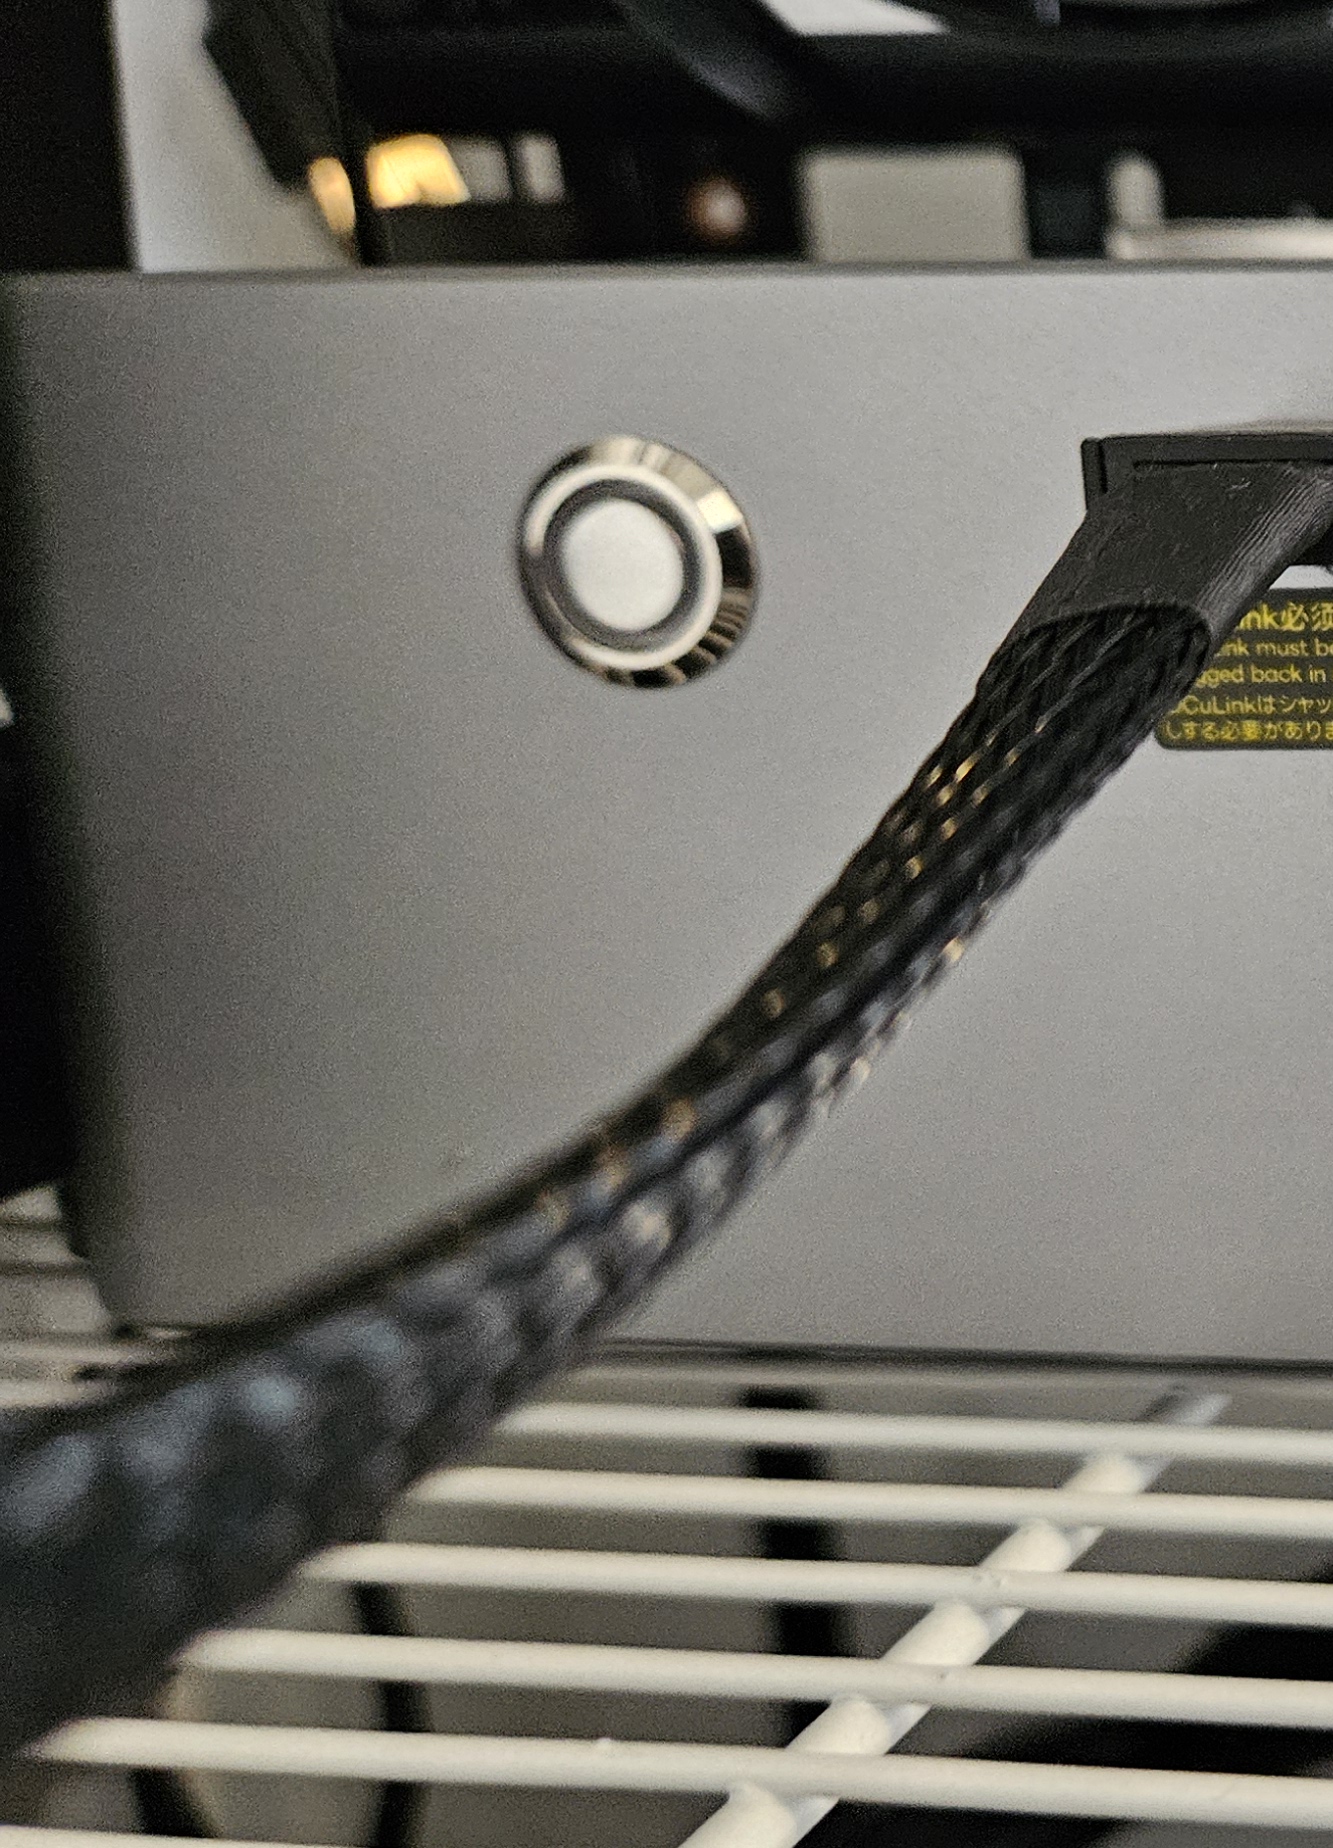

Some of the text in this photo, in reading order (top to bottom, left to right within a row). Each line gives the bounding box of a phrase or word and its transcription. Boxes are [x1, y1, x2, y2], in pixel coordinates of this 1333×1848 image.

[1256, 640, 1309, 657] must
[1251, 664, 1303, 683] back
[1309, 664, 1327, 683] in
